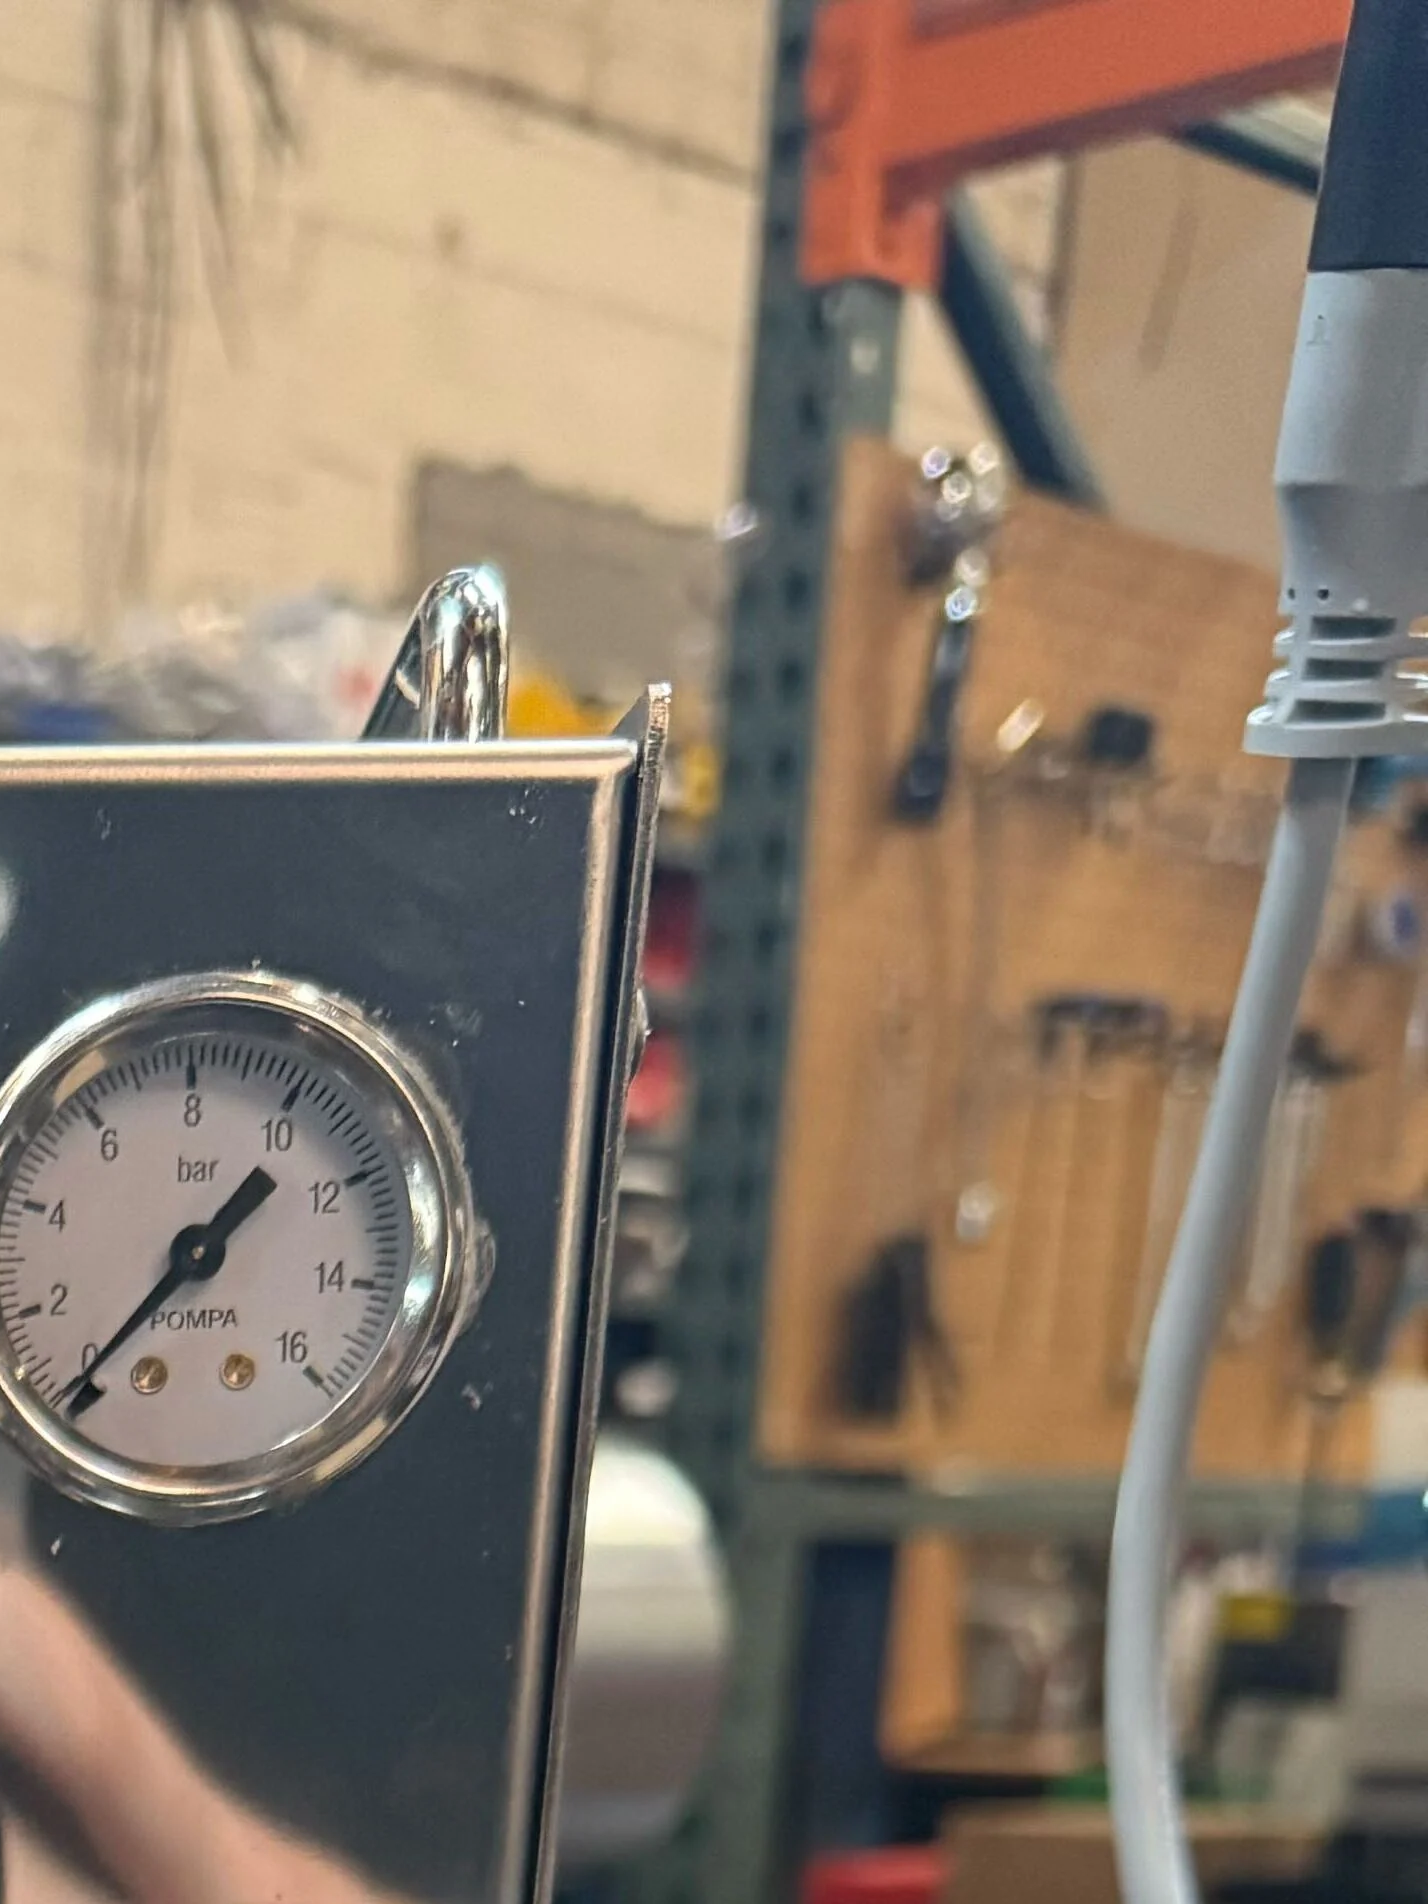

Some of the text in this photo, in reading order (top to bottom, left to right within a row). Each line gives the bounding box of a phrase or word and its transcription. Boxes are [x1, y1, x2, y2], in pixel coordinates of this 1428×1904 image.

[182, 1093, 204, 1128] 8
[99, 1129, 119, 1163] 6
[261, 1117, 294, 1153] 10
[176, 1154, 219, 1184] bar
[309, 1181, 342, 1216] 12
[47, 1200, 67, 1233] 4
[314, 1260, 345, 1294] 14
[49, 1285, 69, 1317] 2
[149, 1307, 239, 1332] POMPA
[276, 1330, 309, 1364] 16
